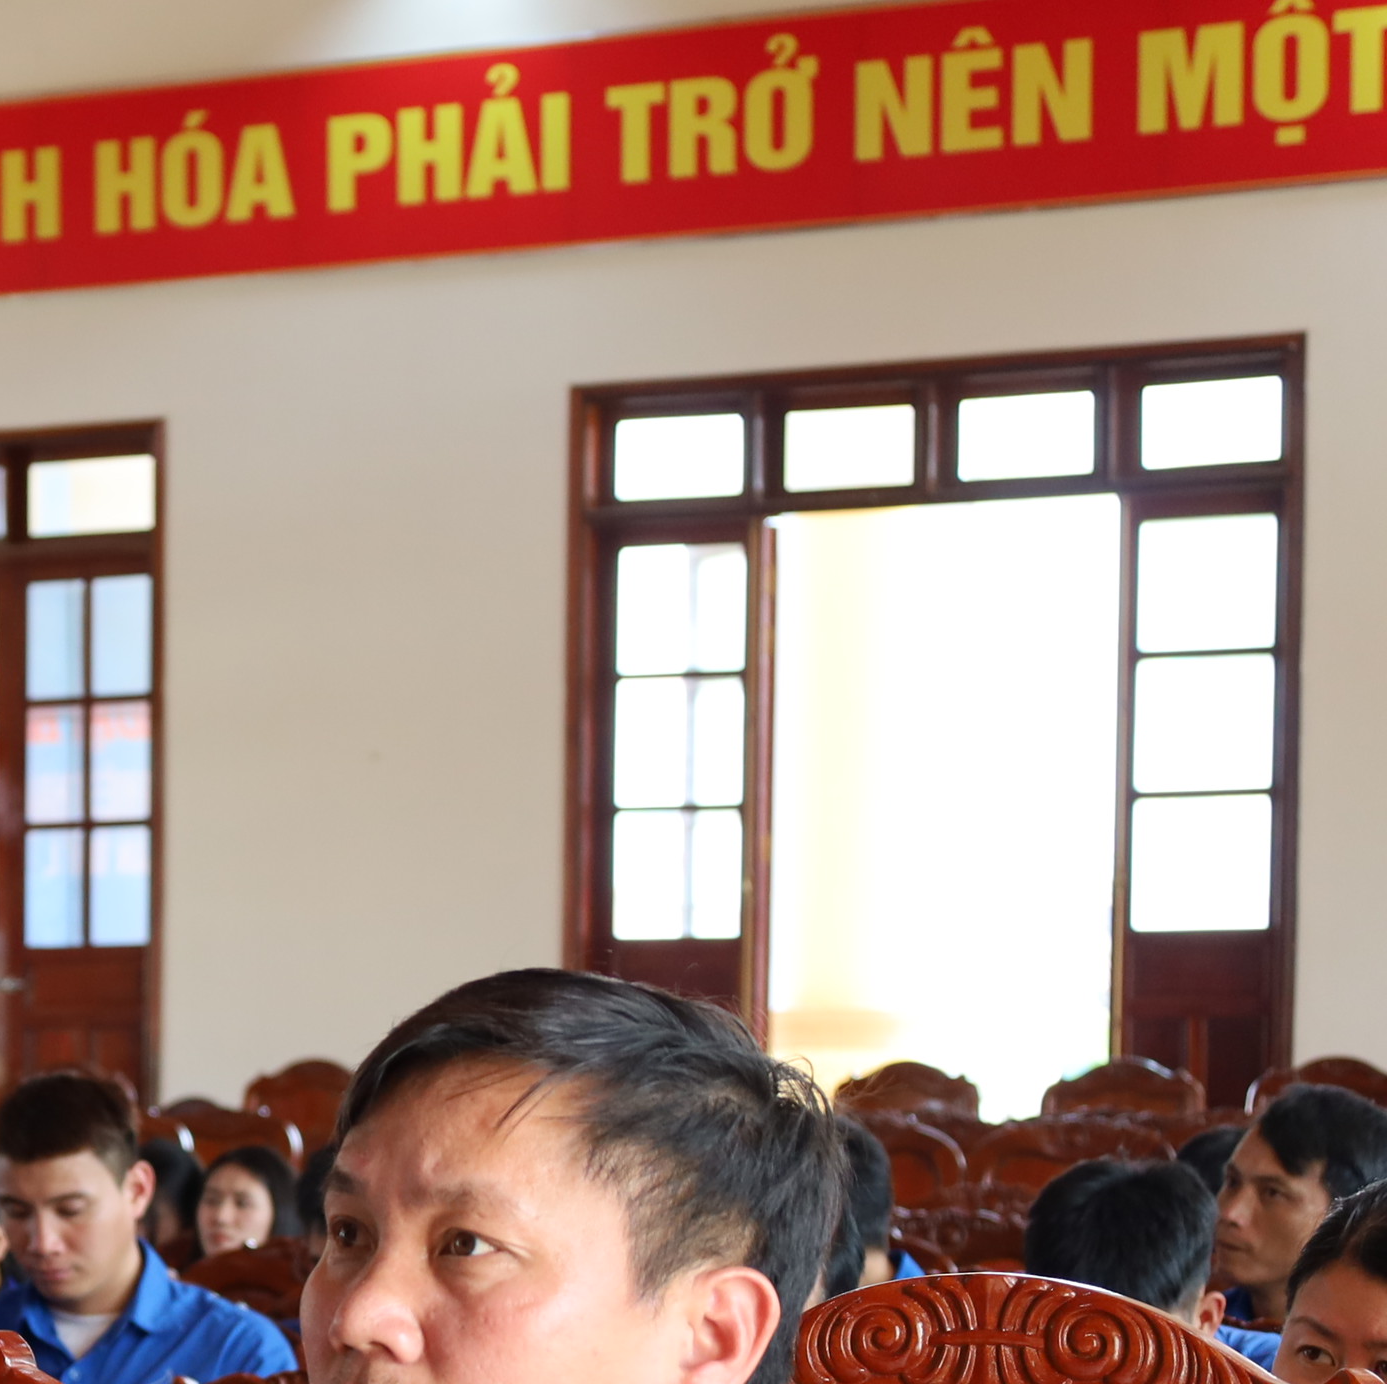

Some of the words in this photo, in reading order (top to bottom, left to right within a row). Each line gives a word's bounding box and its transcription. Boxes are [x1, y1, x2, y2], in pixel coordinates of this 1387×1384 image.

[94, 108, 296, 236] HÓA
[326, 62, 571, 214] PHẢI
[604, 32, 819, 185] TRỞ
[853, 26, 1093, 162] NÊN
[1136, 0, 1387, 146] MỘT
